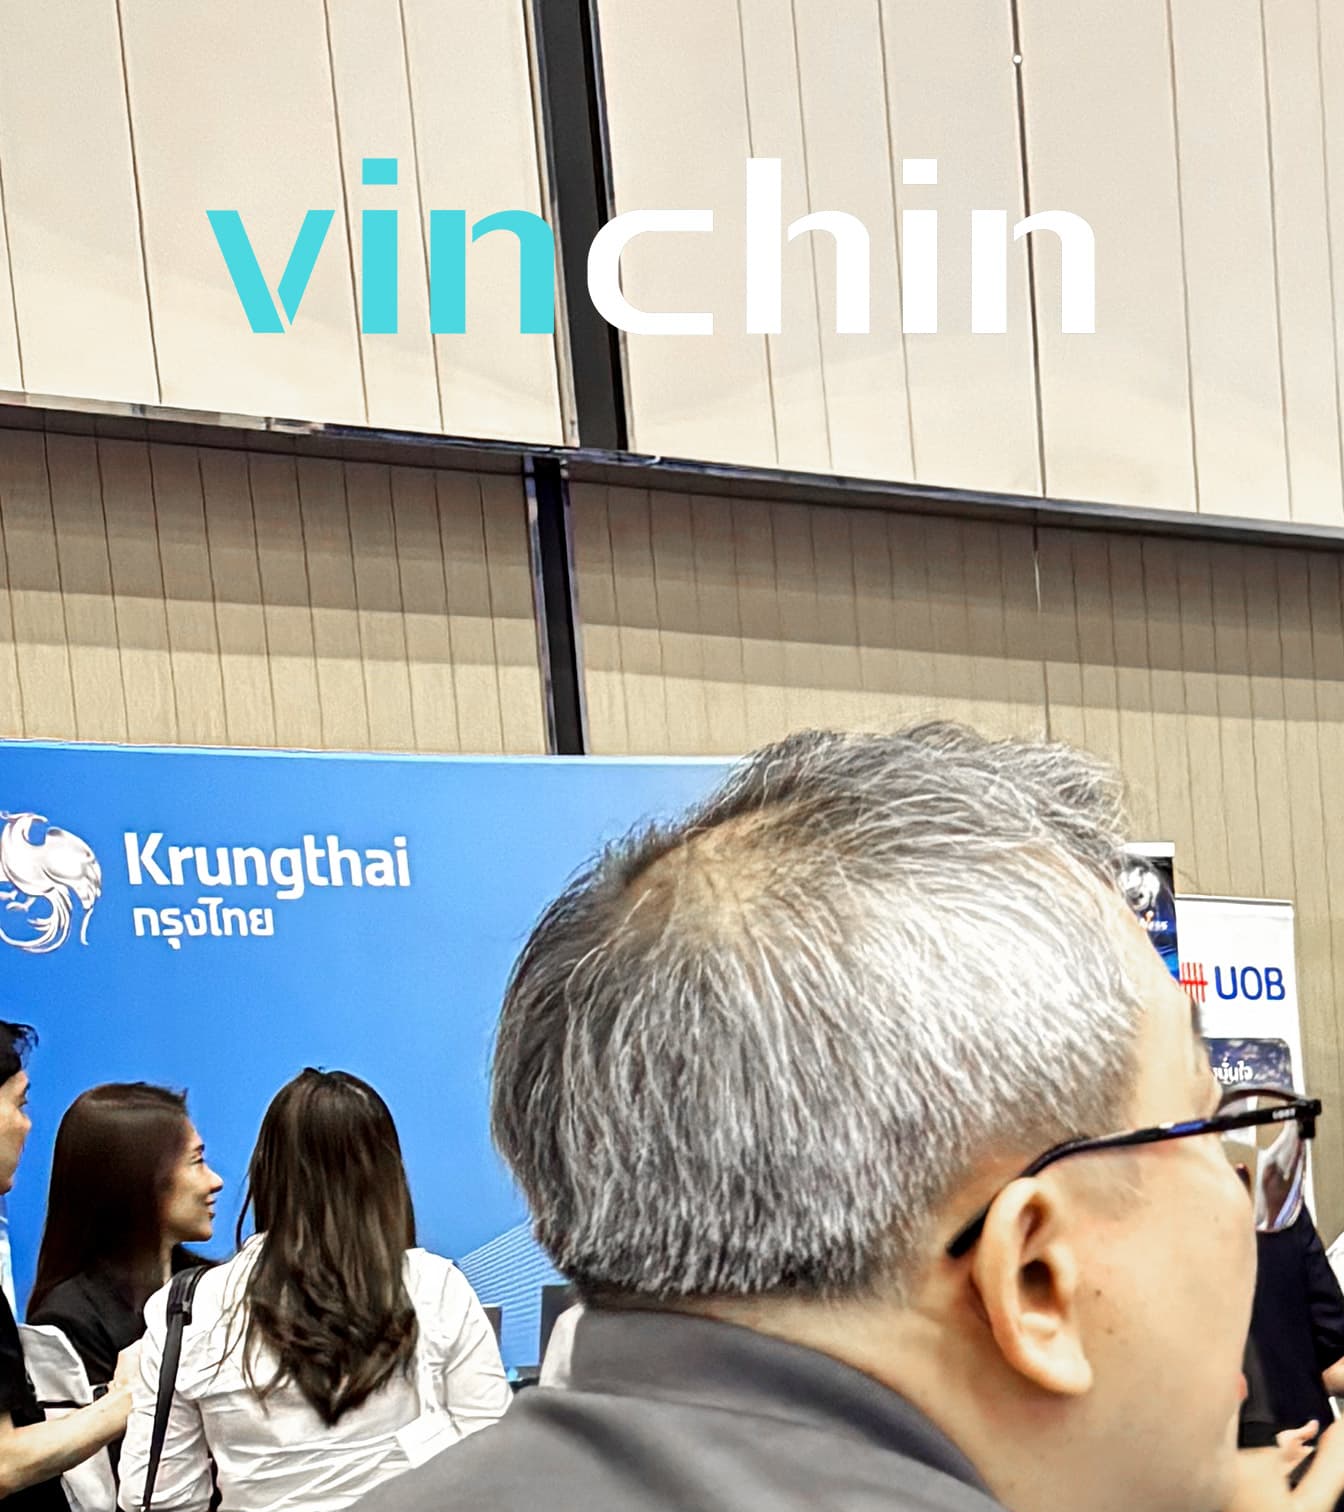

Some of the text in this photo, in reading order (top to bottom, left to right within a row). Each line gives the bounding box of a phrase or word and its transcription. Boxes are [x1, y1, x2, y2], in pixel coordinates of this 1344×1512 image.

[124, 832, 410, 900] Krungthai
[133, 897, 274, 950] กรุงไทย
[1214, 966, 1286, 1000] UOB
